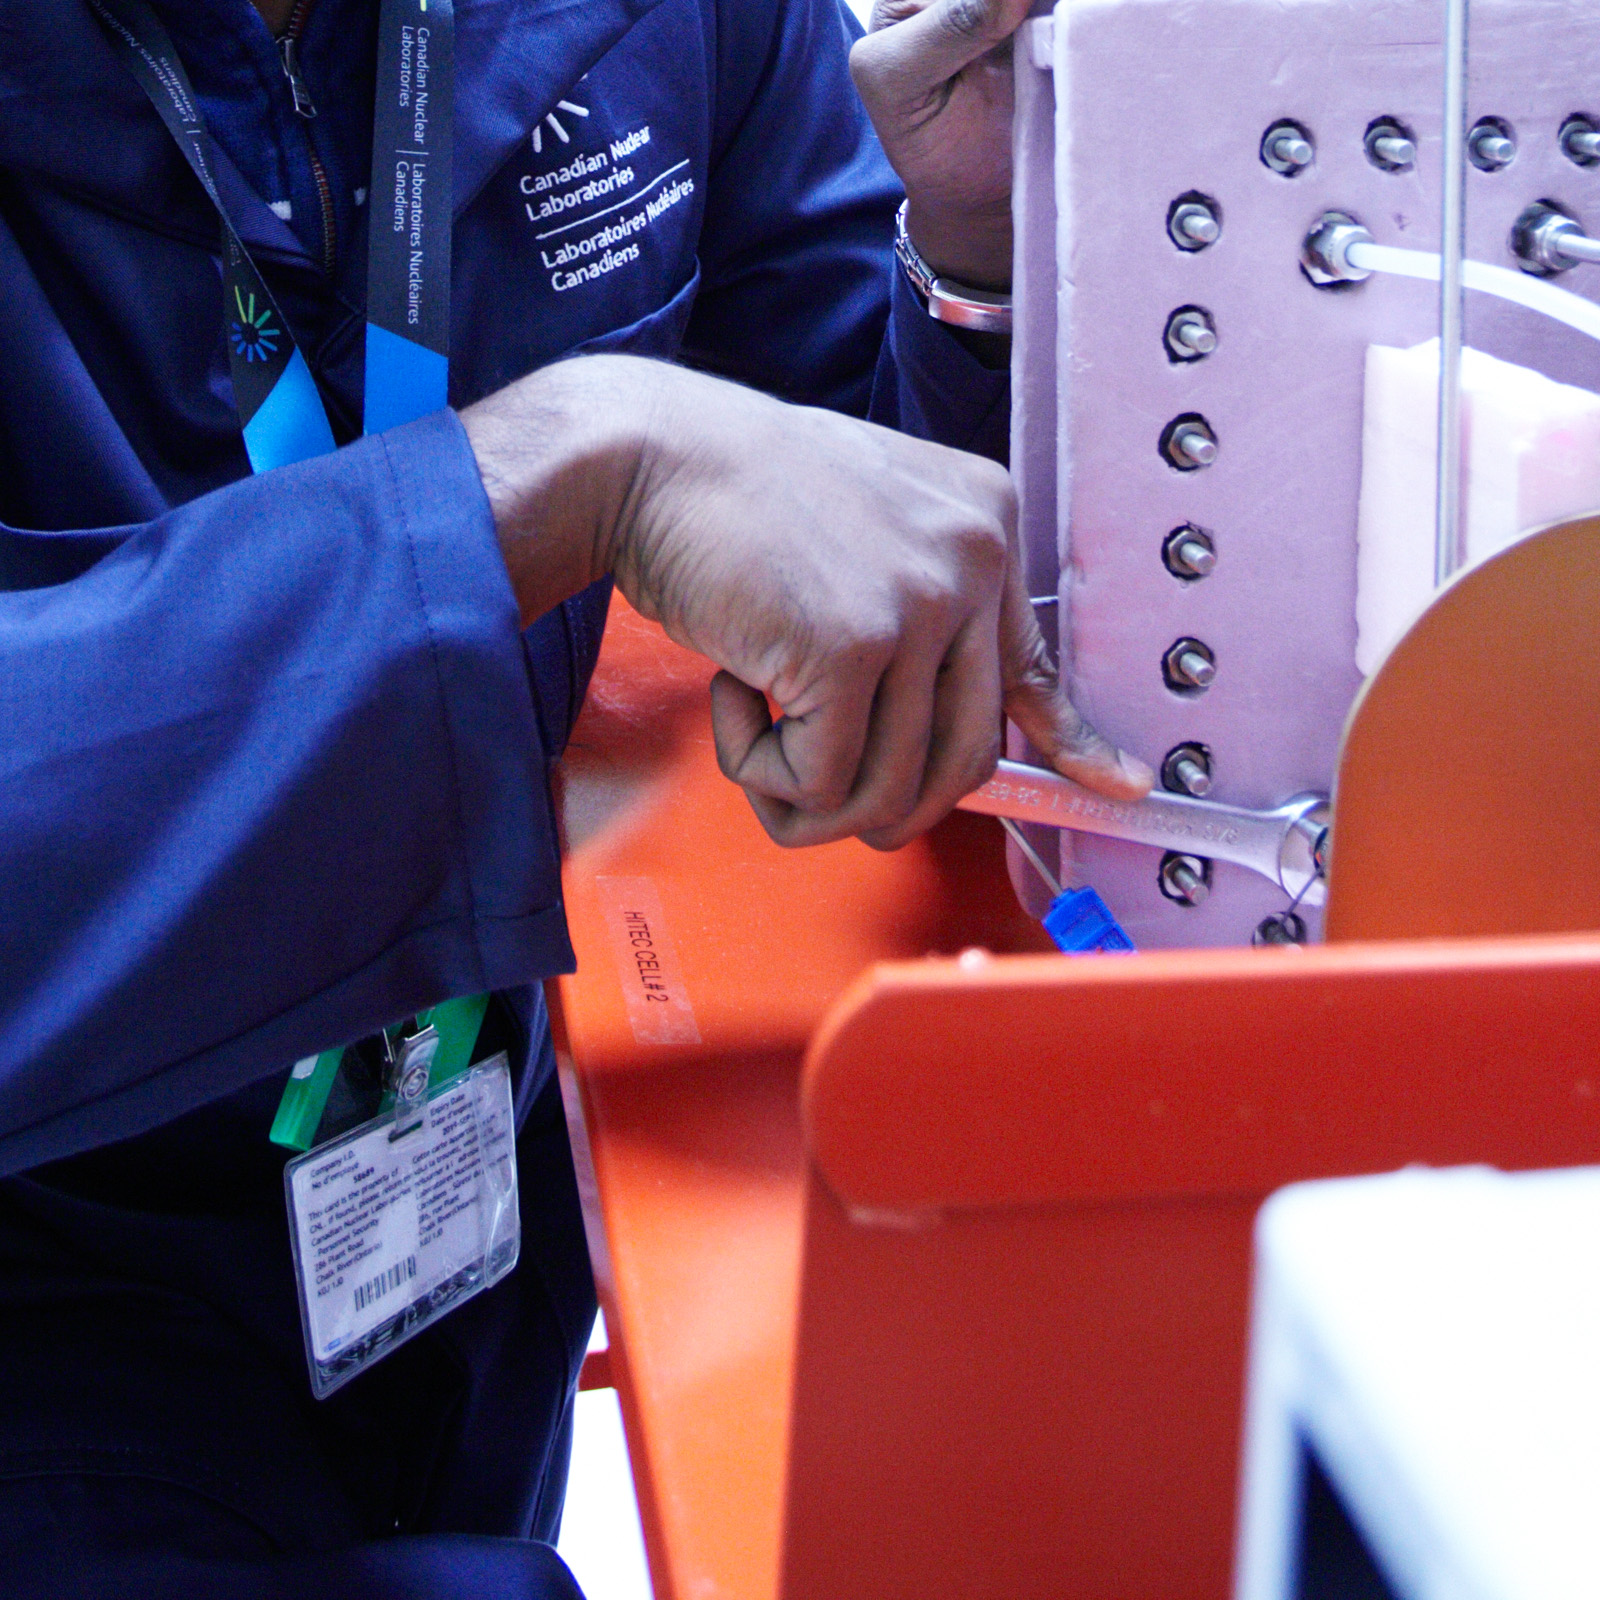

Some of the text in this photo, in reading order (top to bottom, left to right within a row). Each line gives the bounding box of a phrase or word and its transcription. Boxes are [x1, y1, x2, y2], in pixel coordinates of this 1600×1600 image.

[399, 25, 414, 108] Laboratories
[414, 26, 430, 145] Canadian Nuclear
[519, 125, 651, 195] Canadian Nuclear
[393, 161, 410, 233] Canadiens
[525, 166, 636, 222] Laboratories
[408, 163, 426, 326] Laboratoires Nucléaires
[540, 211, 647, 269] Laboratoires
[551, 243, 641, 292] Canadiens
[624, 911, 654, 948] HITEC
[311, 1156, 342, 1178] Company
